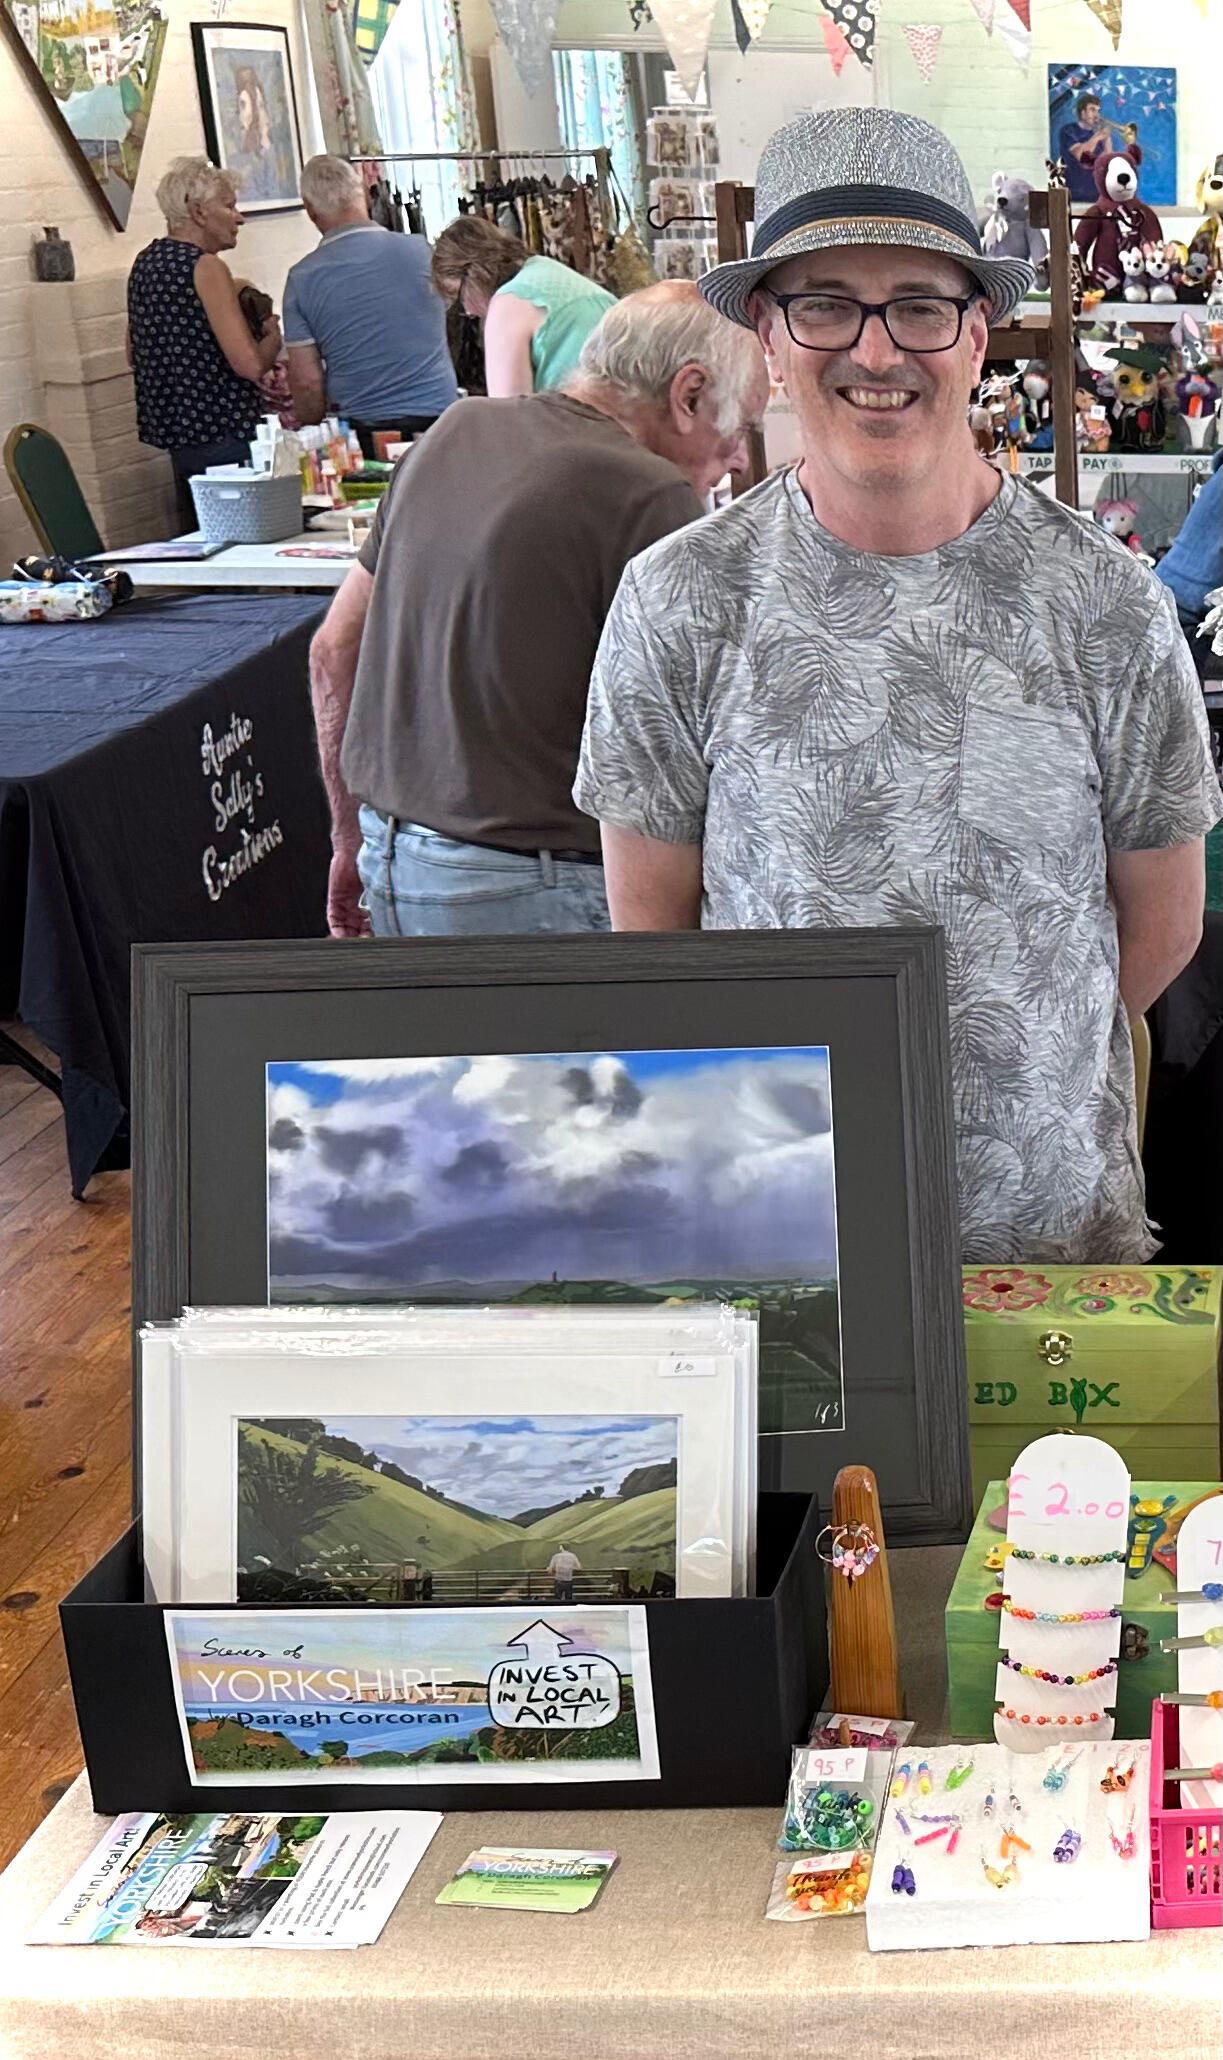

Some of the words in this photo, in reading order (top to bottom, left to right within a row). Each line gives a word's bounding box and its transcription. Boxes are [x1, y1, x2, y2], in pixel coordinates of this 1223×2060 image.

[1028, 457, 1053, 468] TAP
[1083, 458, 1107, 470] PAY
[211, 754, 264, 833] Sally's
[202, 819, 284, 901] Creations
[201, 1638, 271, 1658] Scenes
[283, 1645, 305, 1660] of
[499, 1663, 598, 1685] INVEST
[198, 1667, 456, 1703] YORKSHIRE
[497, 1690, 517, 1705] IN
[527, 1687, 611, 1704] LOCAL
[236, 1711, 332, 1727] Daragh
[339, 1711, 459, 1726] Corcoran
[814, 1758, 834, 1776] 95
[115, 1827, 139, 1848] Art!
[93, 1850, 125, 1877] Local
[484, 1861, 600, 1876] YORKSHIRE
[86, 1880, 103, 1891] in
[97, 1828, 194, 1930] YORKSHIRE
[58, 1893, 91, 1926] Invest
